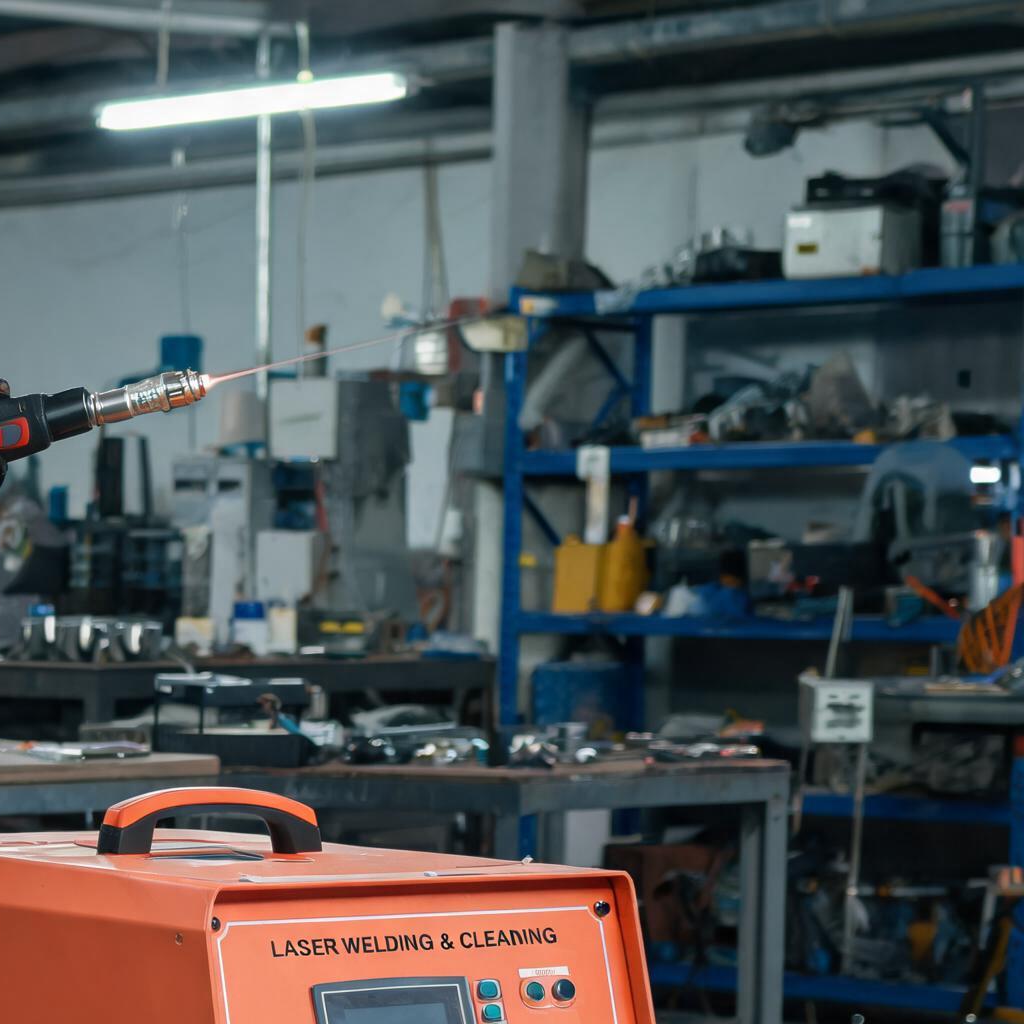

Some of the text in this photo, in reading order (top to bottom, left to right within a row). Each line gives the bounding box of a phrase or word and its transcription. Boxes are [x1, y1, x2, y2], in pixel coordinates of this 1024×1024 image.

[270, 938, 340, 958] LASER
[341, 934, 434, 954] WELDING
[440, 933, 455, 950] &
